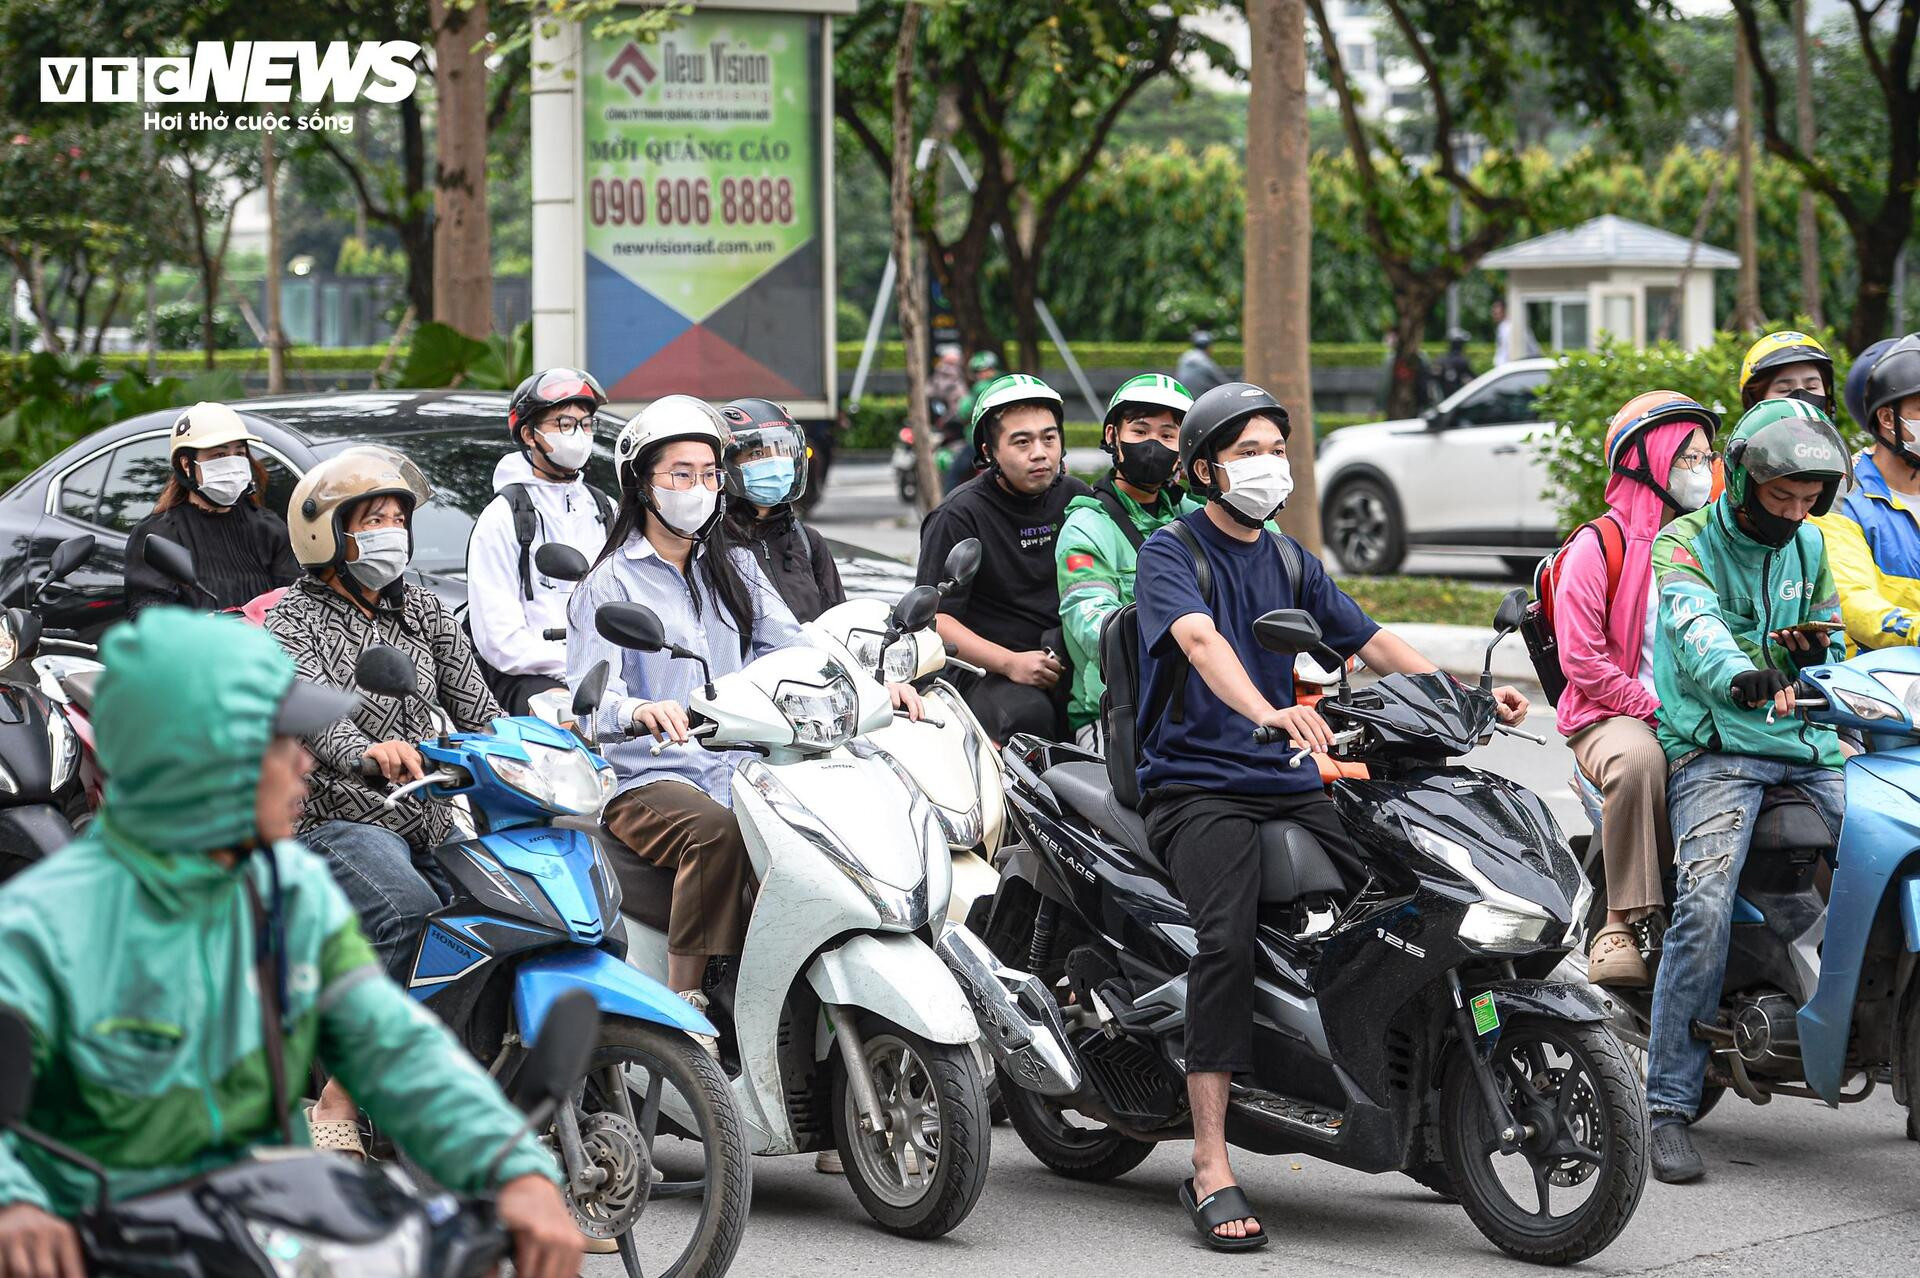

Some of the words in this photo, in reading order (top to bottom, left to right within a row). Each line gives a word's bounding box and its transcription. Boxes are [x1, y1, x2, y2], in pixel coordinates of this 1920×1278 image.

[664, 41, 706, 84] New
[710, 41, 769, 84] Vision
[588, 137, 638, 161] MỜI
[645, 134, 732, 165] QUẢNG
[739, 136, 790, 161] CÁO
[591, 178, 645, 226] 090
[656, 178, 711, 226] 806
[721, 178, 793, 226] 8888
[613, 239, 776, 256] newvisionad.com.vn
[1794, 443, 1831, 460] Grab
[431, 929, 471, 960] HONDA
[1376, 927, 1426, 958] 125
